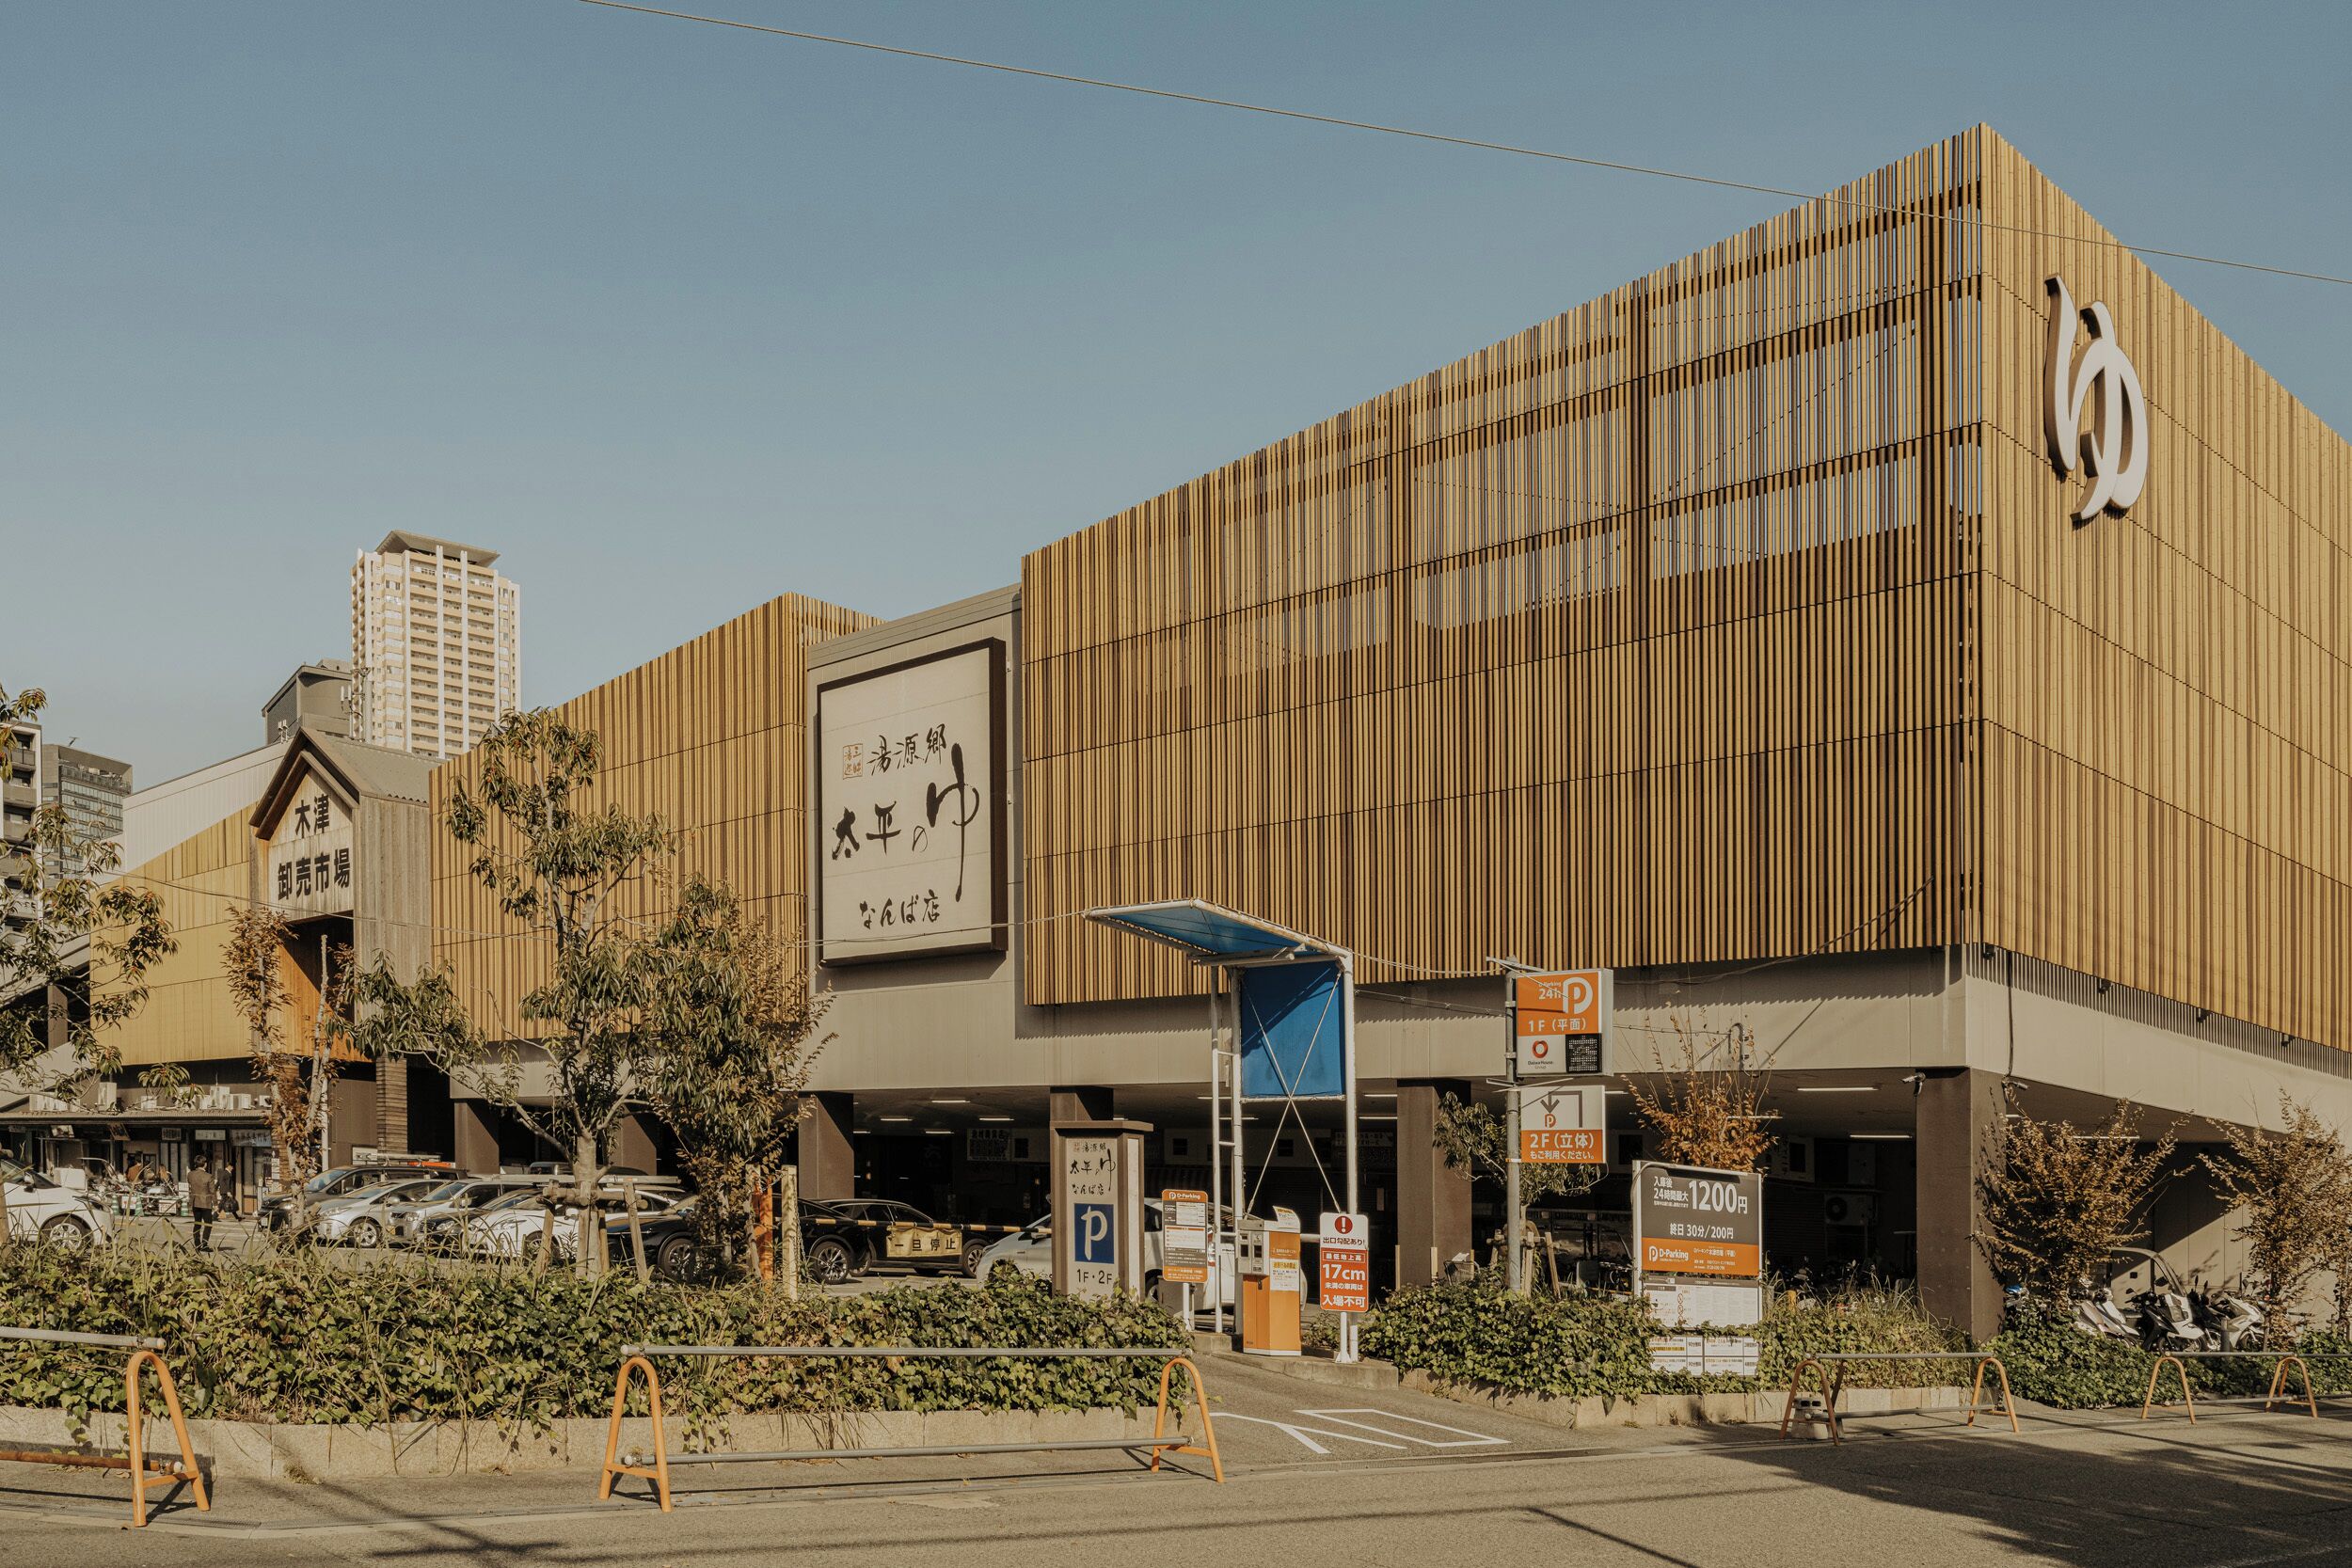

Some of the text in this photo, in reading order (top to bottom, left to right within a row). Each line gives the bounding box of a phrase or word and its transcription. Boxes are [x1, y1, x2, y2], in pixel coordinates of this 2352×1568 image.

[2045, 273, 2149, 520] ゆ
[866, 722, 947, 776] 湯源郷
[294, 794, 329, 838] 木津
[832, 742, 980, 903] 太平のゆ
[278, 847, 351, 900] 卸売市場
[859, 889, 942, 930] なんば店
[1538, 988, 1562, 1001] 24h
[1529, 1132, 1595, 1149] 2F（立体）
[1529, 1150, 1596, 1160] もご利用ください。
[1070, 1148, 1117, 1192] 太平のゆ
[1072, 1183, 1105, 1196] なんば店
[1653, 1176, 1673, 1189] 入庫後
[1653, 1187, 1689, 1202] 24時間最大
[1688, 1180, 1748, 1214] 1200円
[1080, 1205, 1108, 1261] P
[1670, 1223, 1684, 1236] 終日
[895, 1238, 956, 1252] 一旦停止
[1326, 1253, 1362, 1261] 最低地上高
[1322, 1263, 1366, 1281] 17cm
[1325, 1281, 1364, 1291] 未満の車両は
[1322, 1294, 1366, 1308] 入場不可
